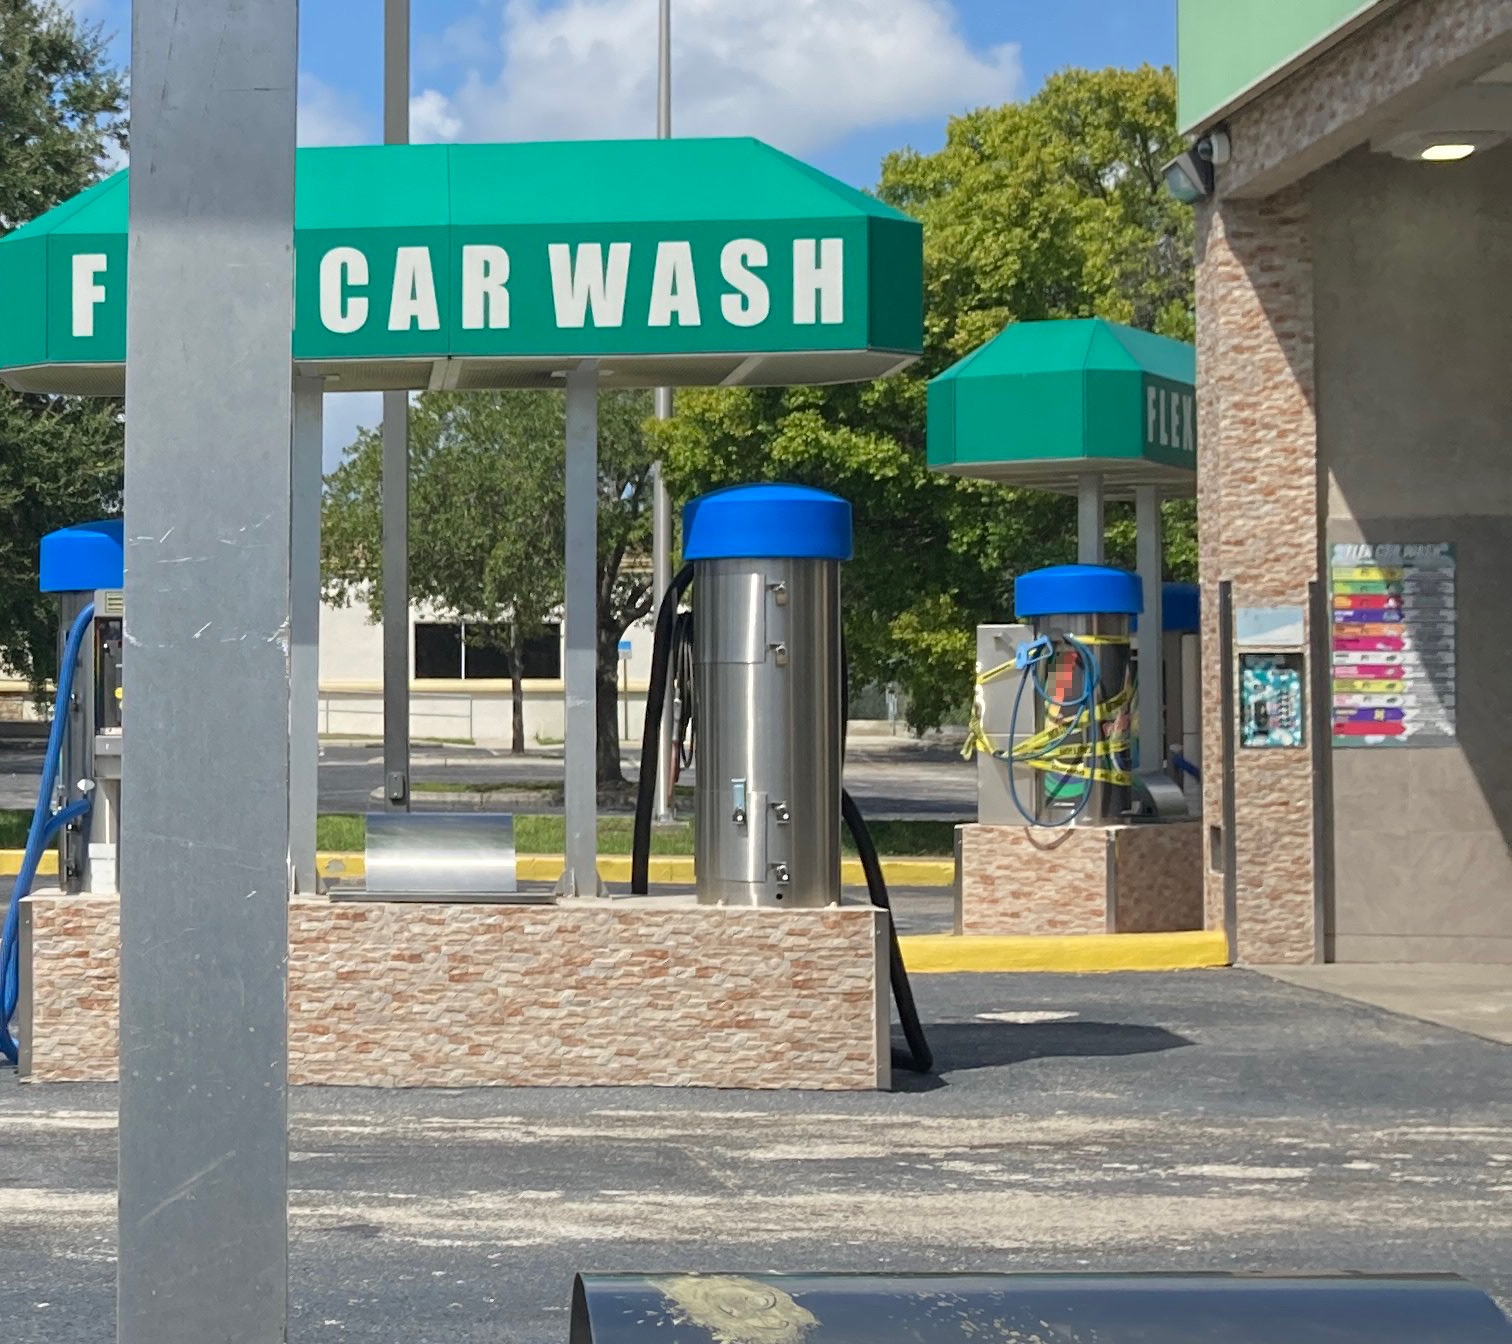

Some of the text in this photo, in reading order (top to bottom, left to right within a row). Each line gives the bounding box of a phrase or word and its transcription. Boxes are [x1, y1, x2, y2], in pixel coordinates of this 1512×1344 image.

[319, 244, 510, 334] CAR
[548, 238, 844, 328] WASH
[1147, 385, 1194, 452] FLEX
